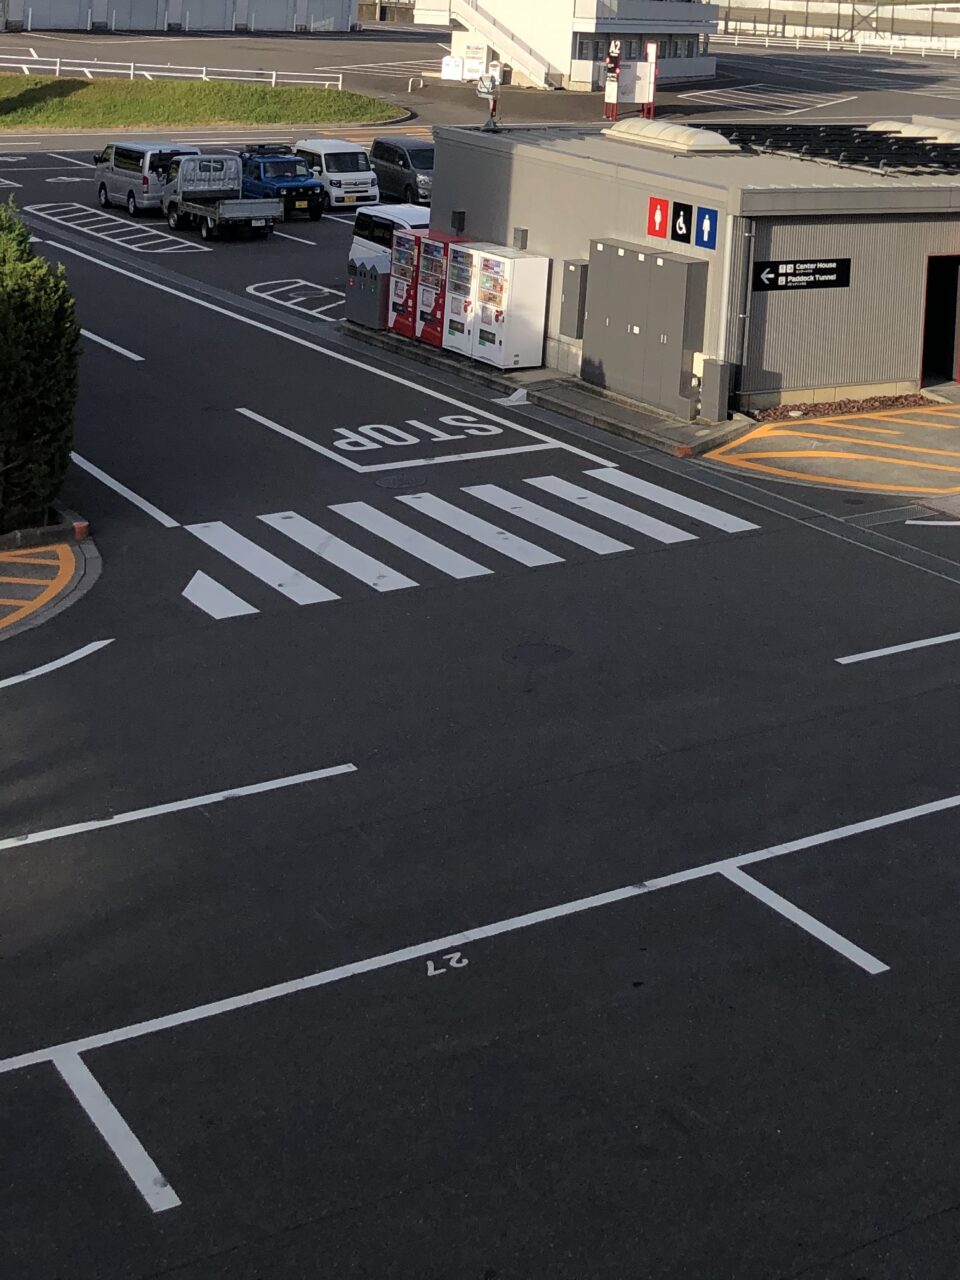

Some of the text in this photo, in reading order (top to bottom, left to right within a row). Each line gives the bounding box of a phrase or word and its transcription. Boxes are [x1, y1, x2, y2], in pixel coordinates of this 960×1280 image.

[609, 40, 621, 54] A2
[333, 415, 503, 451] STOP
[426, 951, 469, 977] 27
